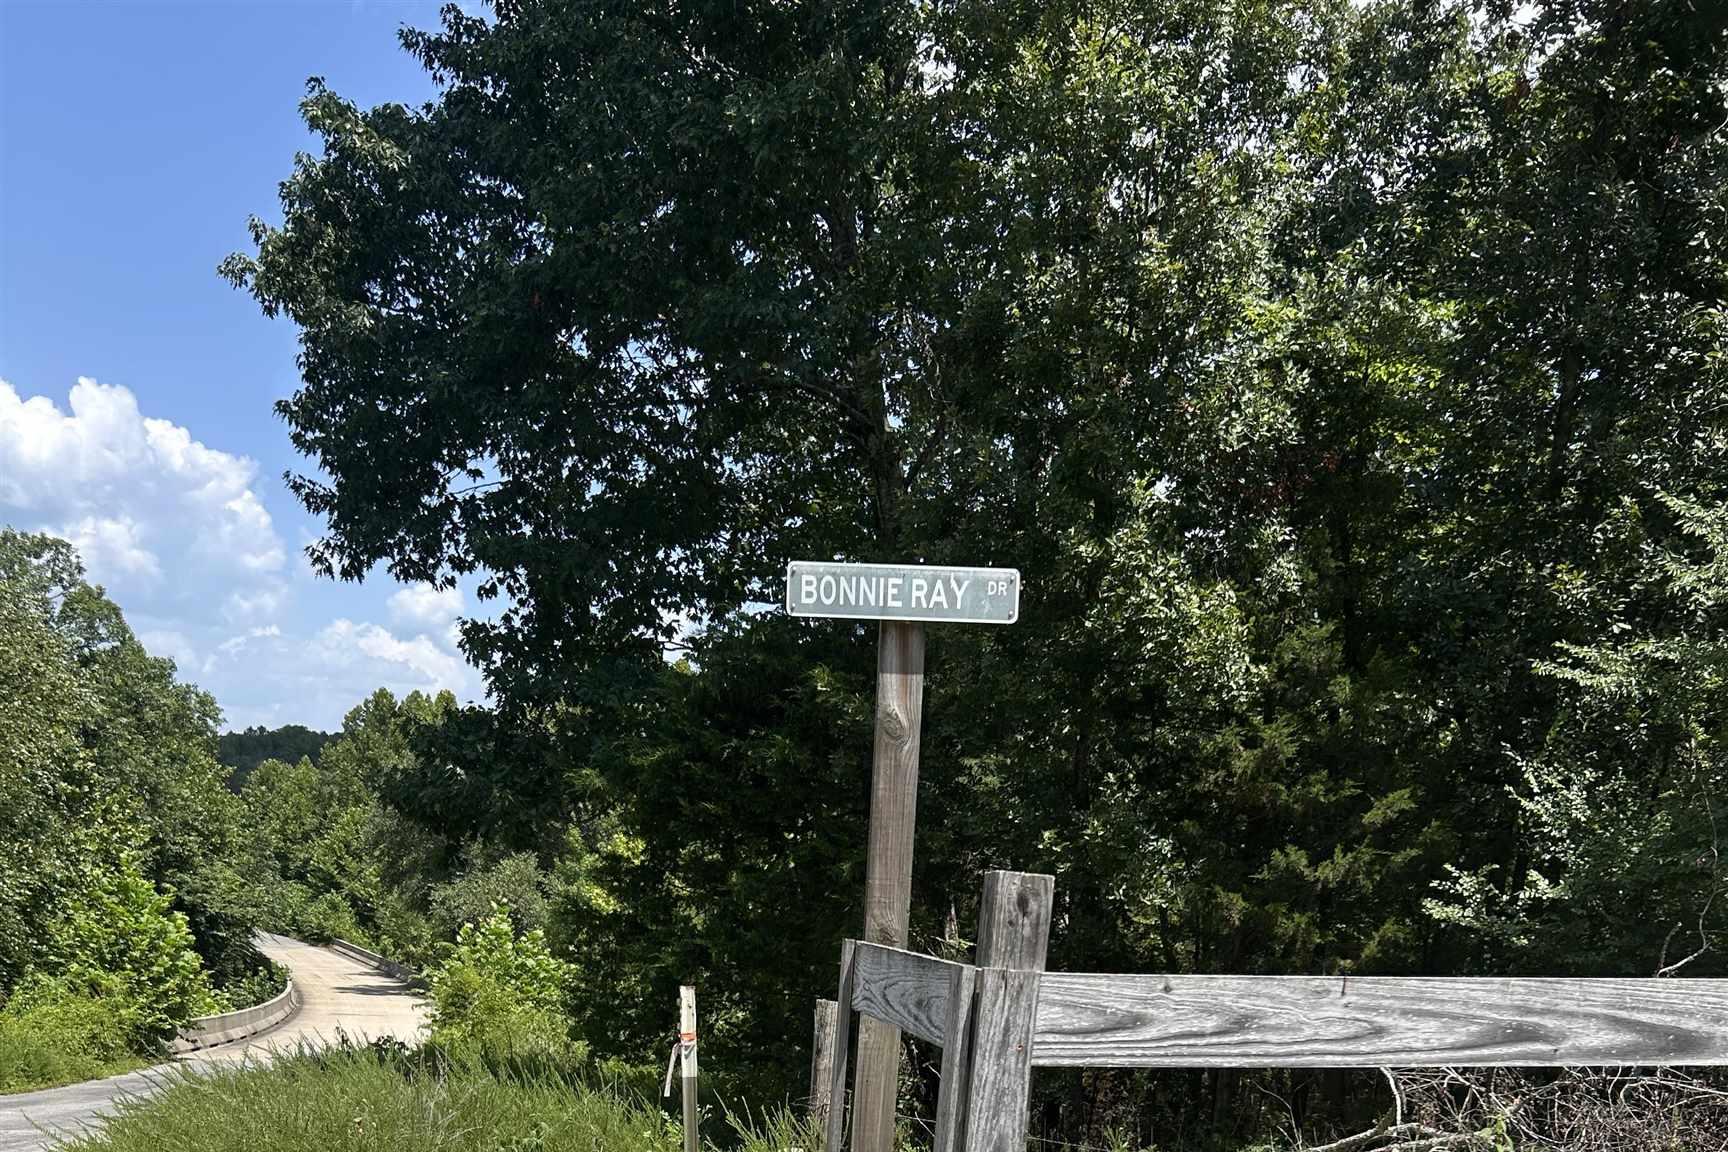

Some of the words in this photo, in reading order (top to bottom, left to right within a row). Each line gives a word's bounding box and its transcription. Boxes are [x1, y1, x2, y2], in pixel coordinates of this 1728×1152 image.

[801, 575, 903, 608] BONNIE
[911, 579, 970, 609] RAY
[987, 581, 1008, 596] DR
